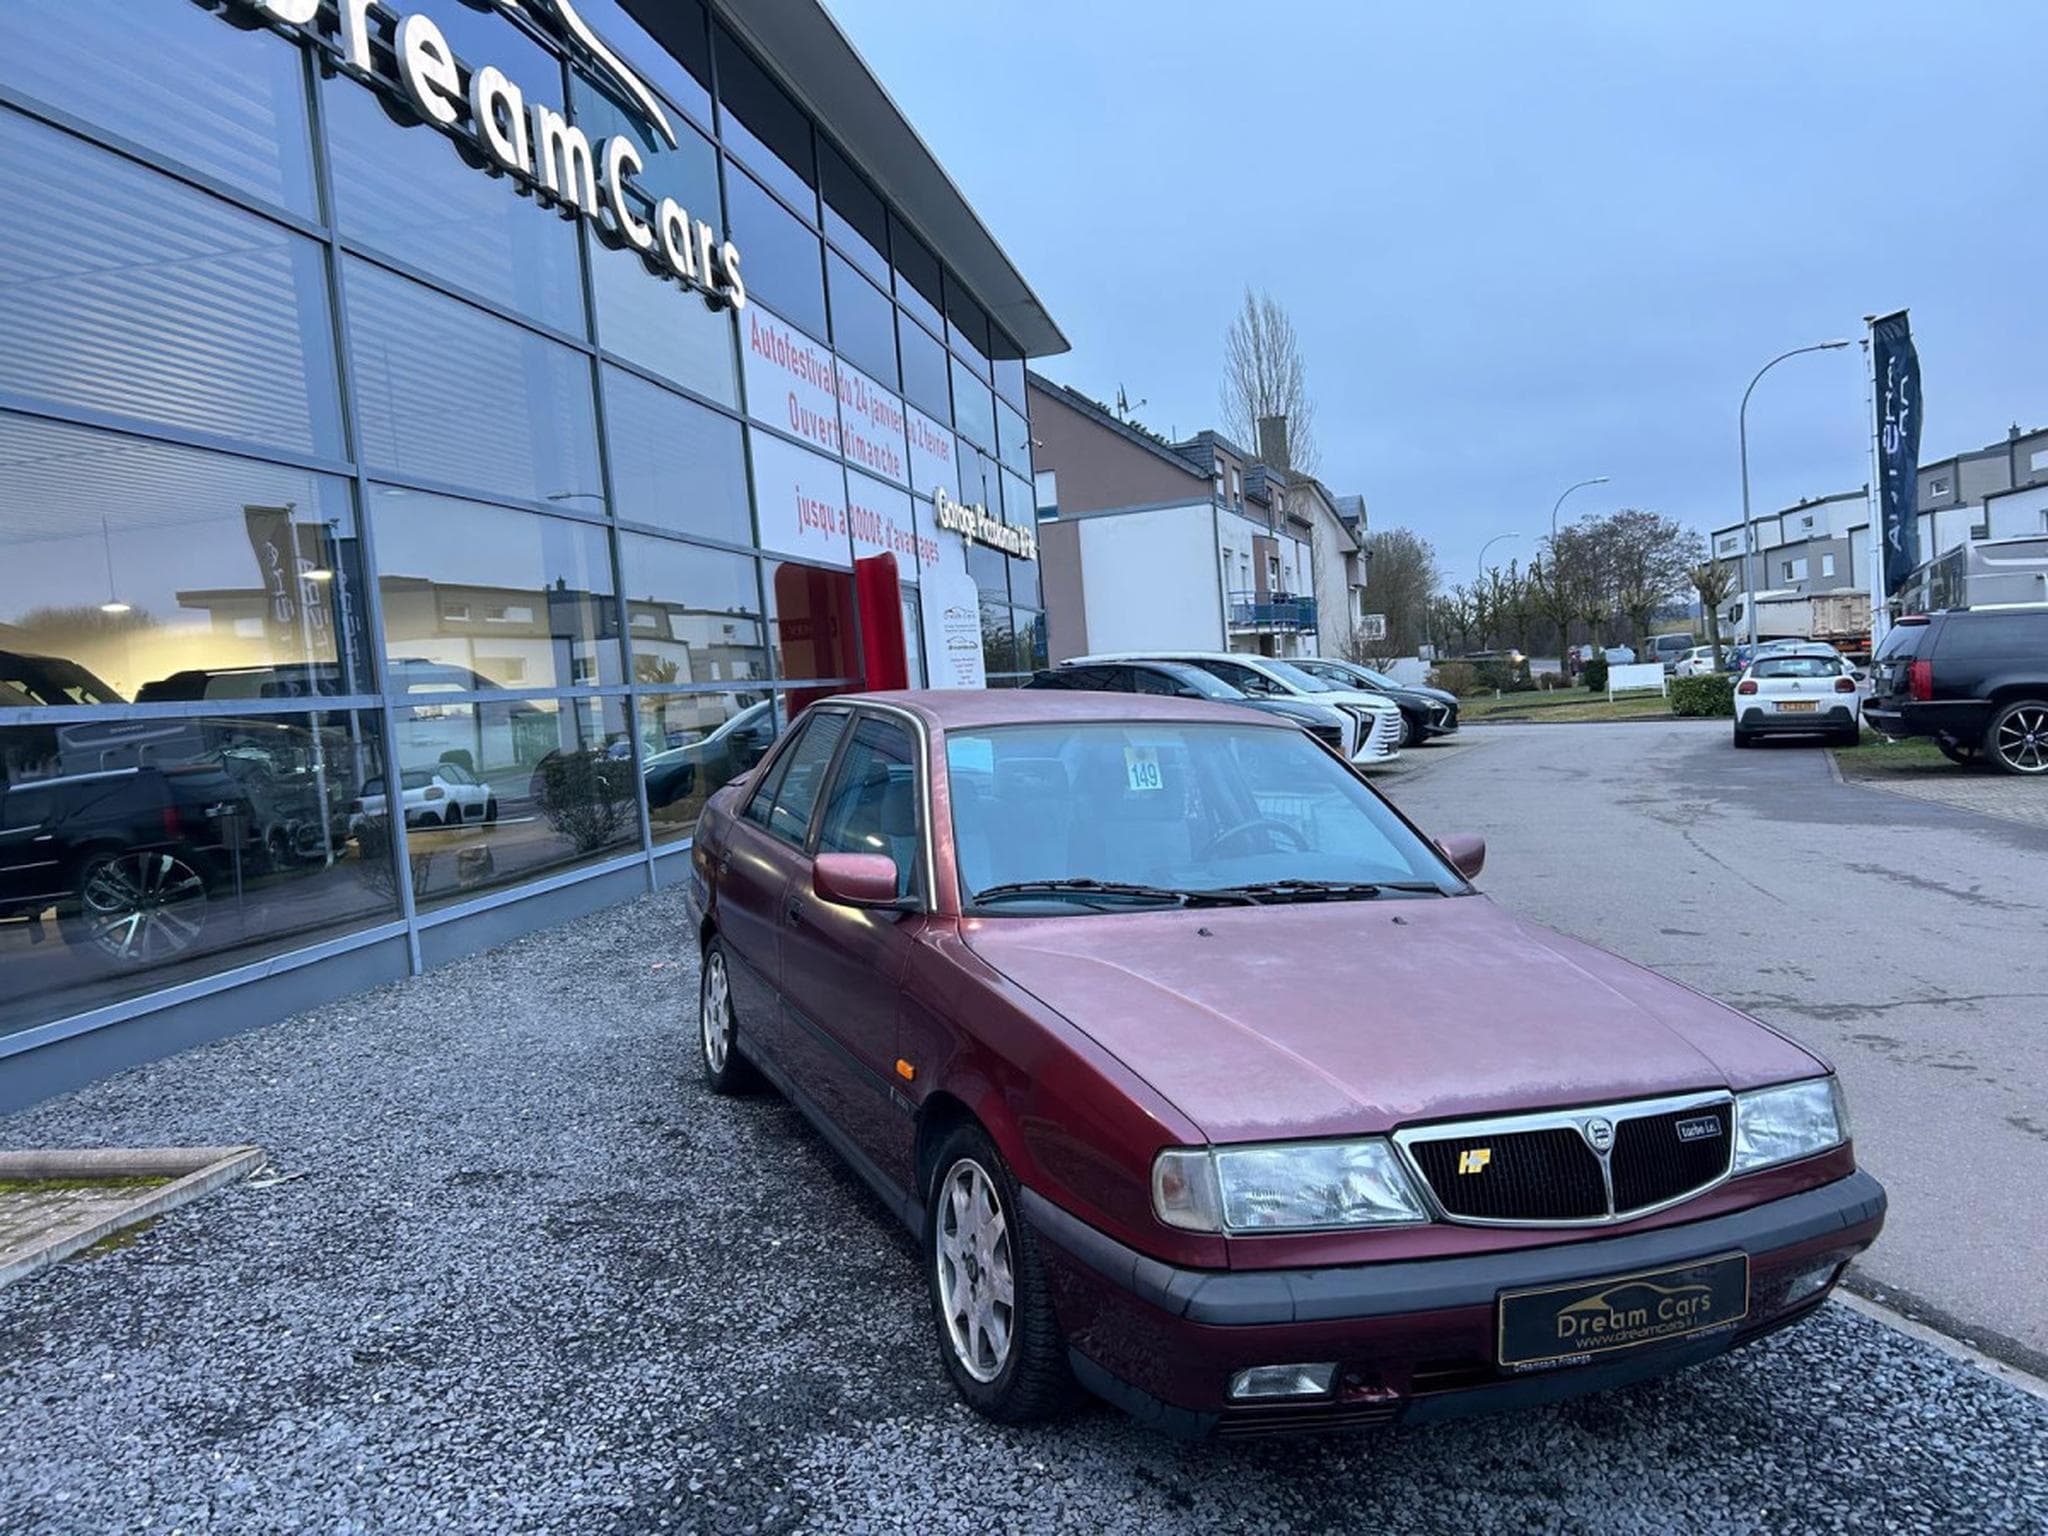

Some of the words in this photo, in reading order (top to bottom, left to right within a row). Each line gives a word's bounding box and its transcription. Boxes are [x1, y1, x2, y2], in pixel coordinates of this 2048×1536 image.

[751, 311, 836, 397] Autofestival
[788, 391, 841, 450] Ouvert
[843, 422, 901, 478] dimanche
[886, 517, 940, 568] d'avanages
[1131, 763, 1158, 788] 149
[1459, 1148, 1491, 1174] HF
[1557, 1307, 1647, 1338] Dream
[1658, 1294, 1712, 1320] Cars
